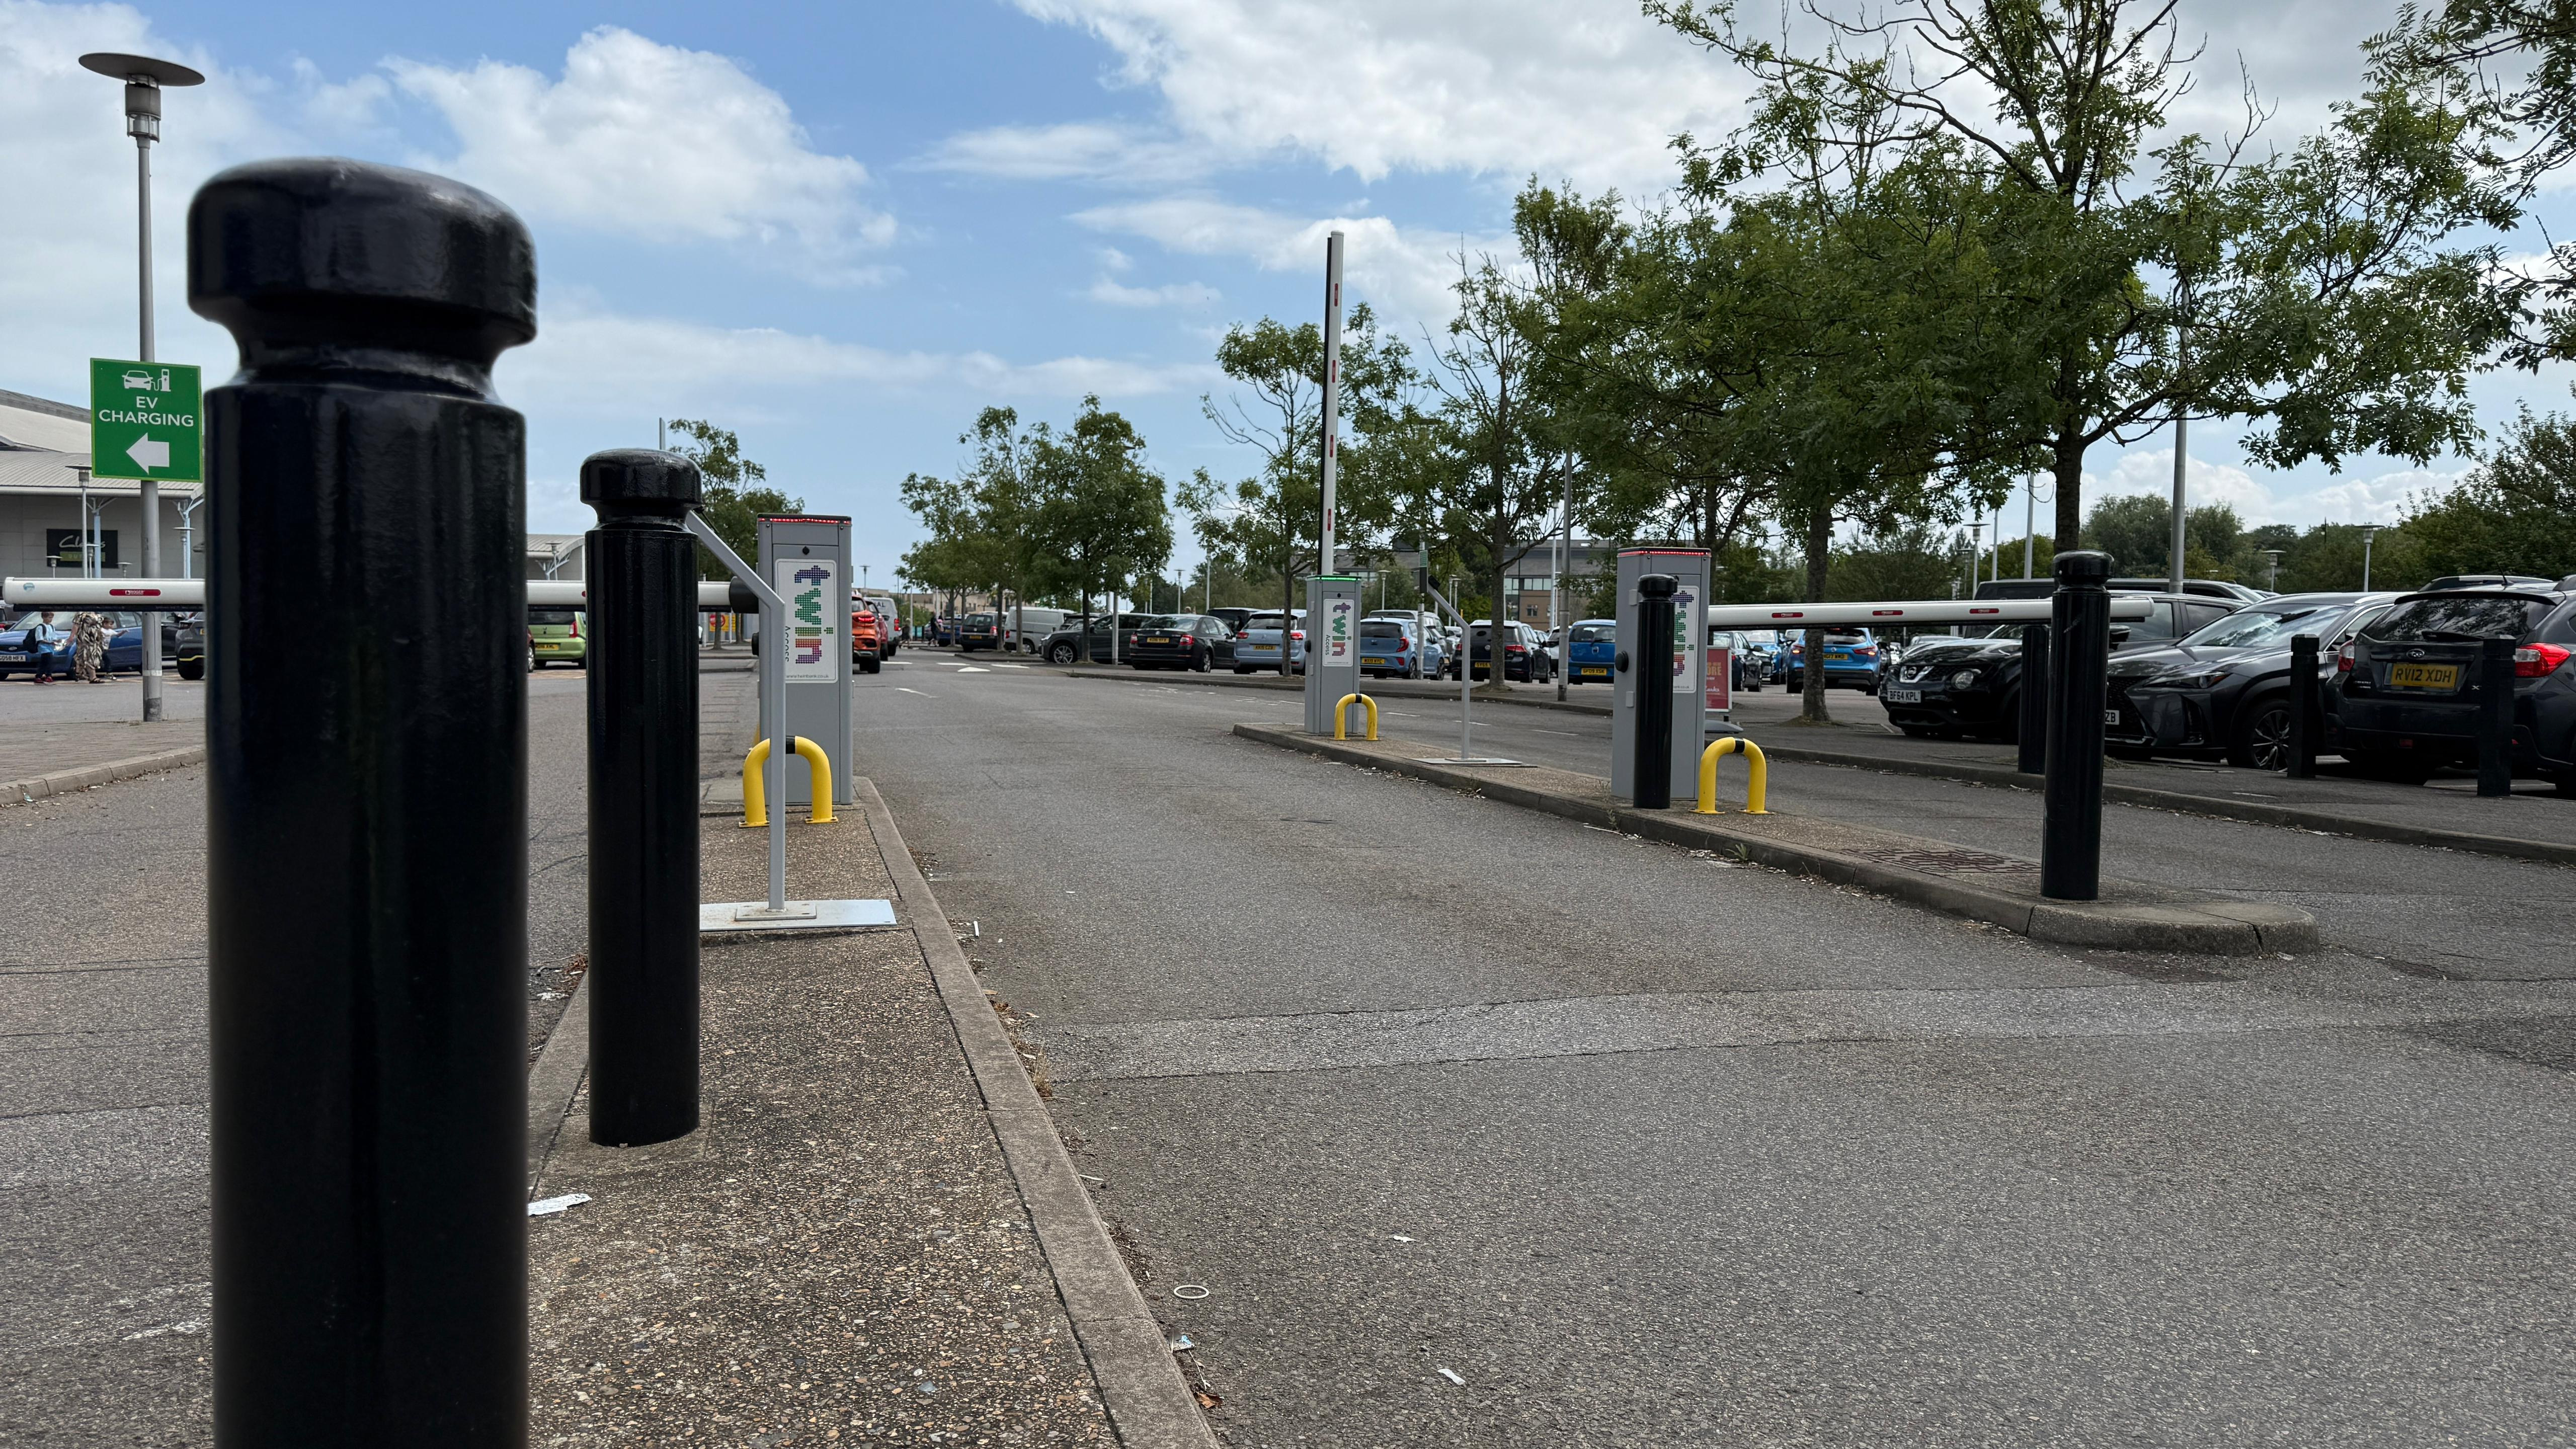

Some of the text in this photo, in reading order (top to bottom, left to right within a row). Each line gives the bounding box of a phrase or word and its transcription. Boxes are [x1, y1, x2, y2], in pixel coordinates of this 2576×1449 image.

[136, 396, 158, 409] EV
[99, 410, 194, 427] CHARGING
[794, 565, 833, 664] twin
[1332, 602, 1351, 656] twin
[2395, 668, 2452, 683] RV12 XDH
[1890, 690, 1918, 701] BF64 KPL
[2105, 712, 2116, 722] ZB
